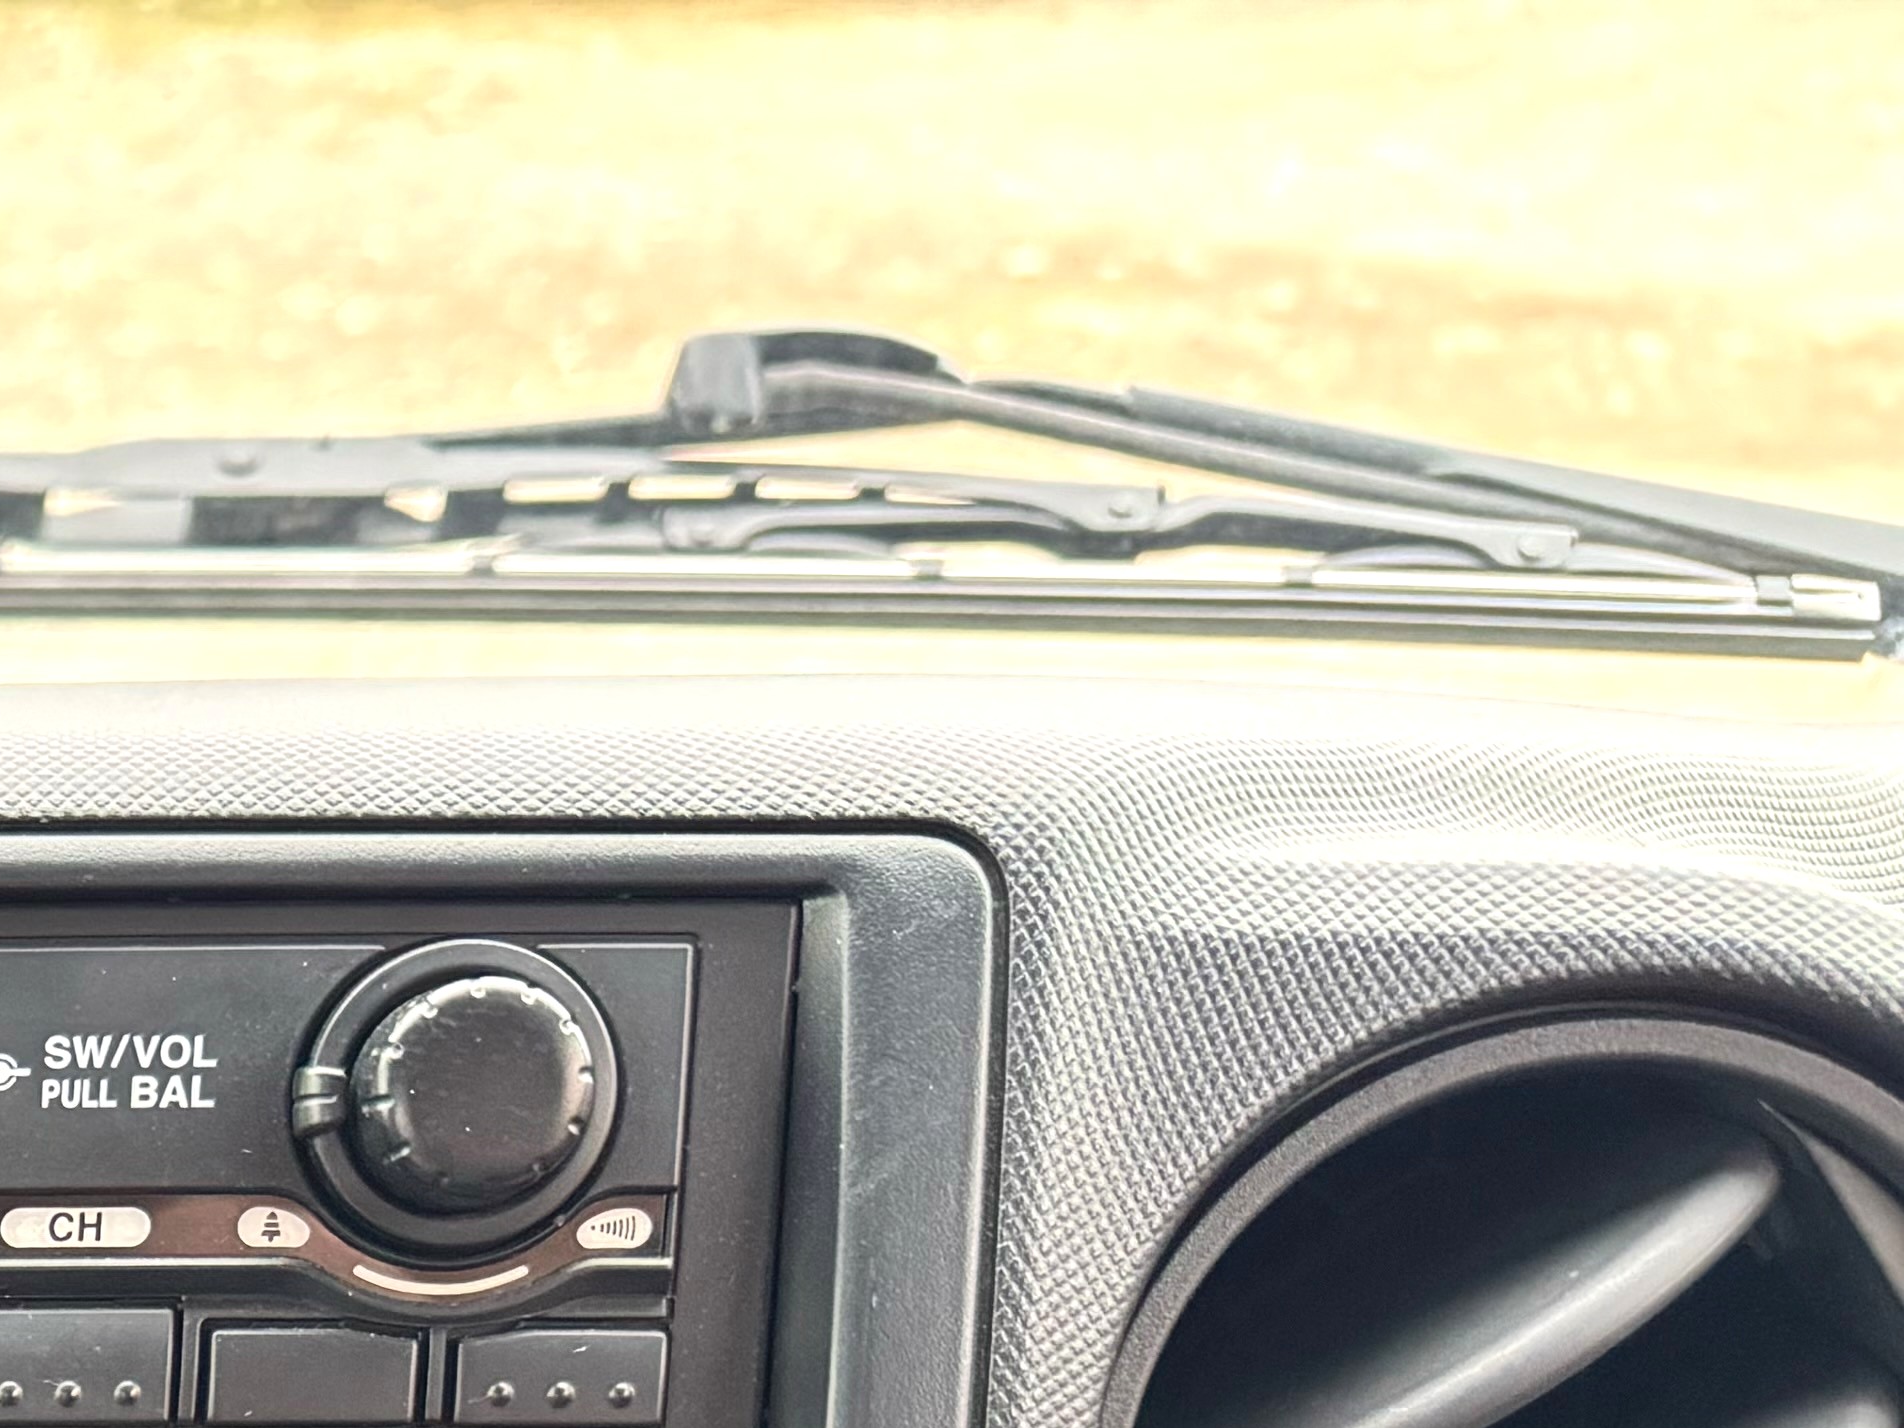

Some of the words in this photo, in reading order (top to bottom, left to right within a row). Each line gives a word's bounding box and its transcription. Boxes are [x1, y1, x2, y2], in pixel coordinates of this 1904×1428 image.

[44, 1034, 218, 1069] SW/VOL
[40, 1076, 118, 1109] PULL
[130, 1076, 215, 1109] BAL
[47, 1211, 104, 1243] CH
